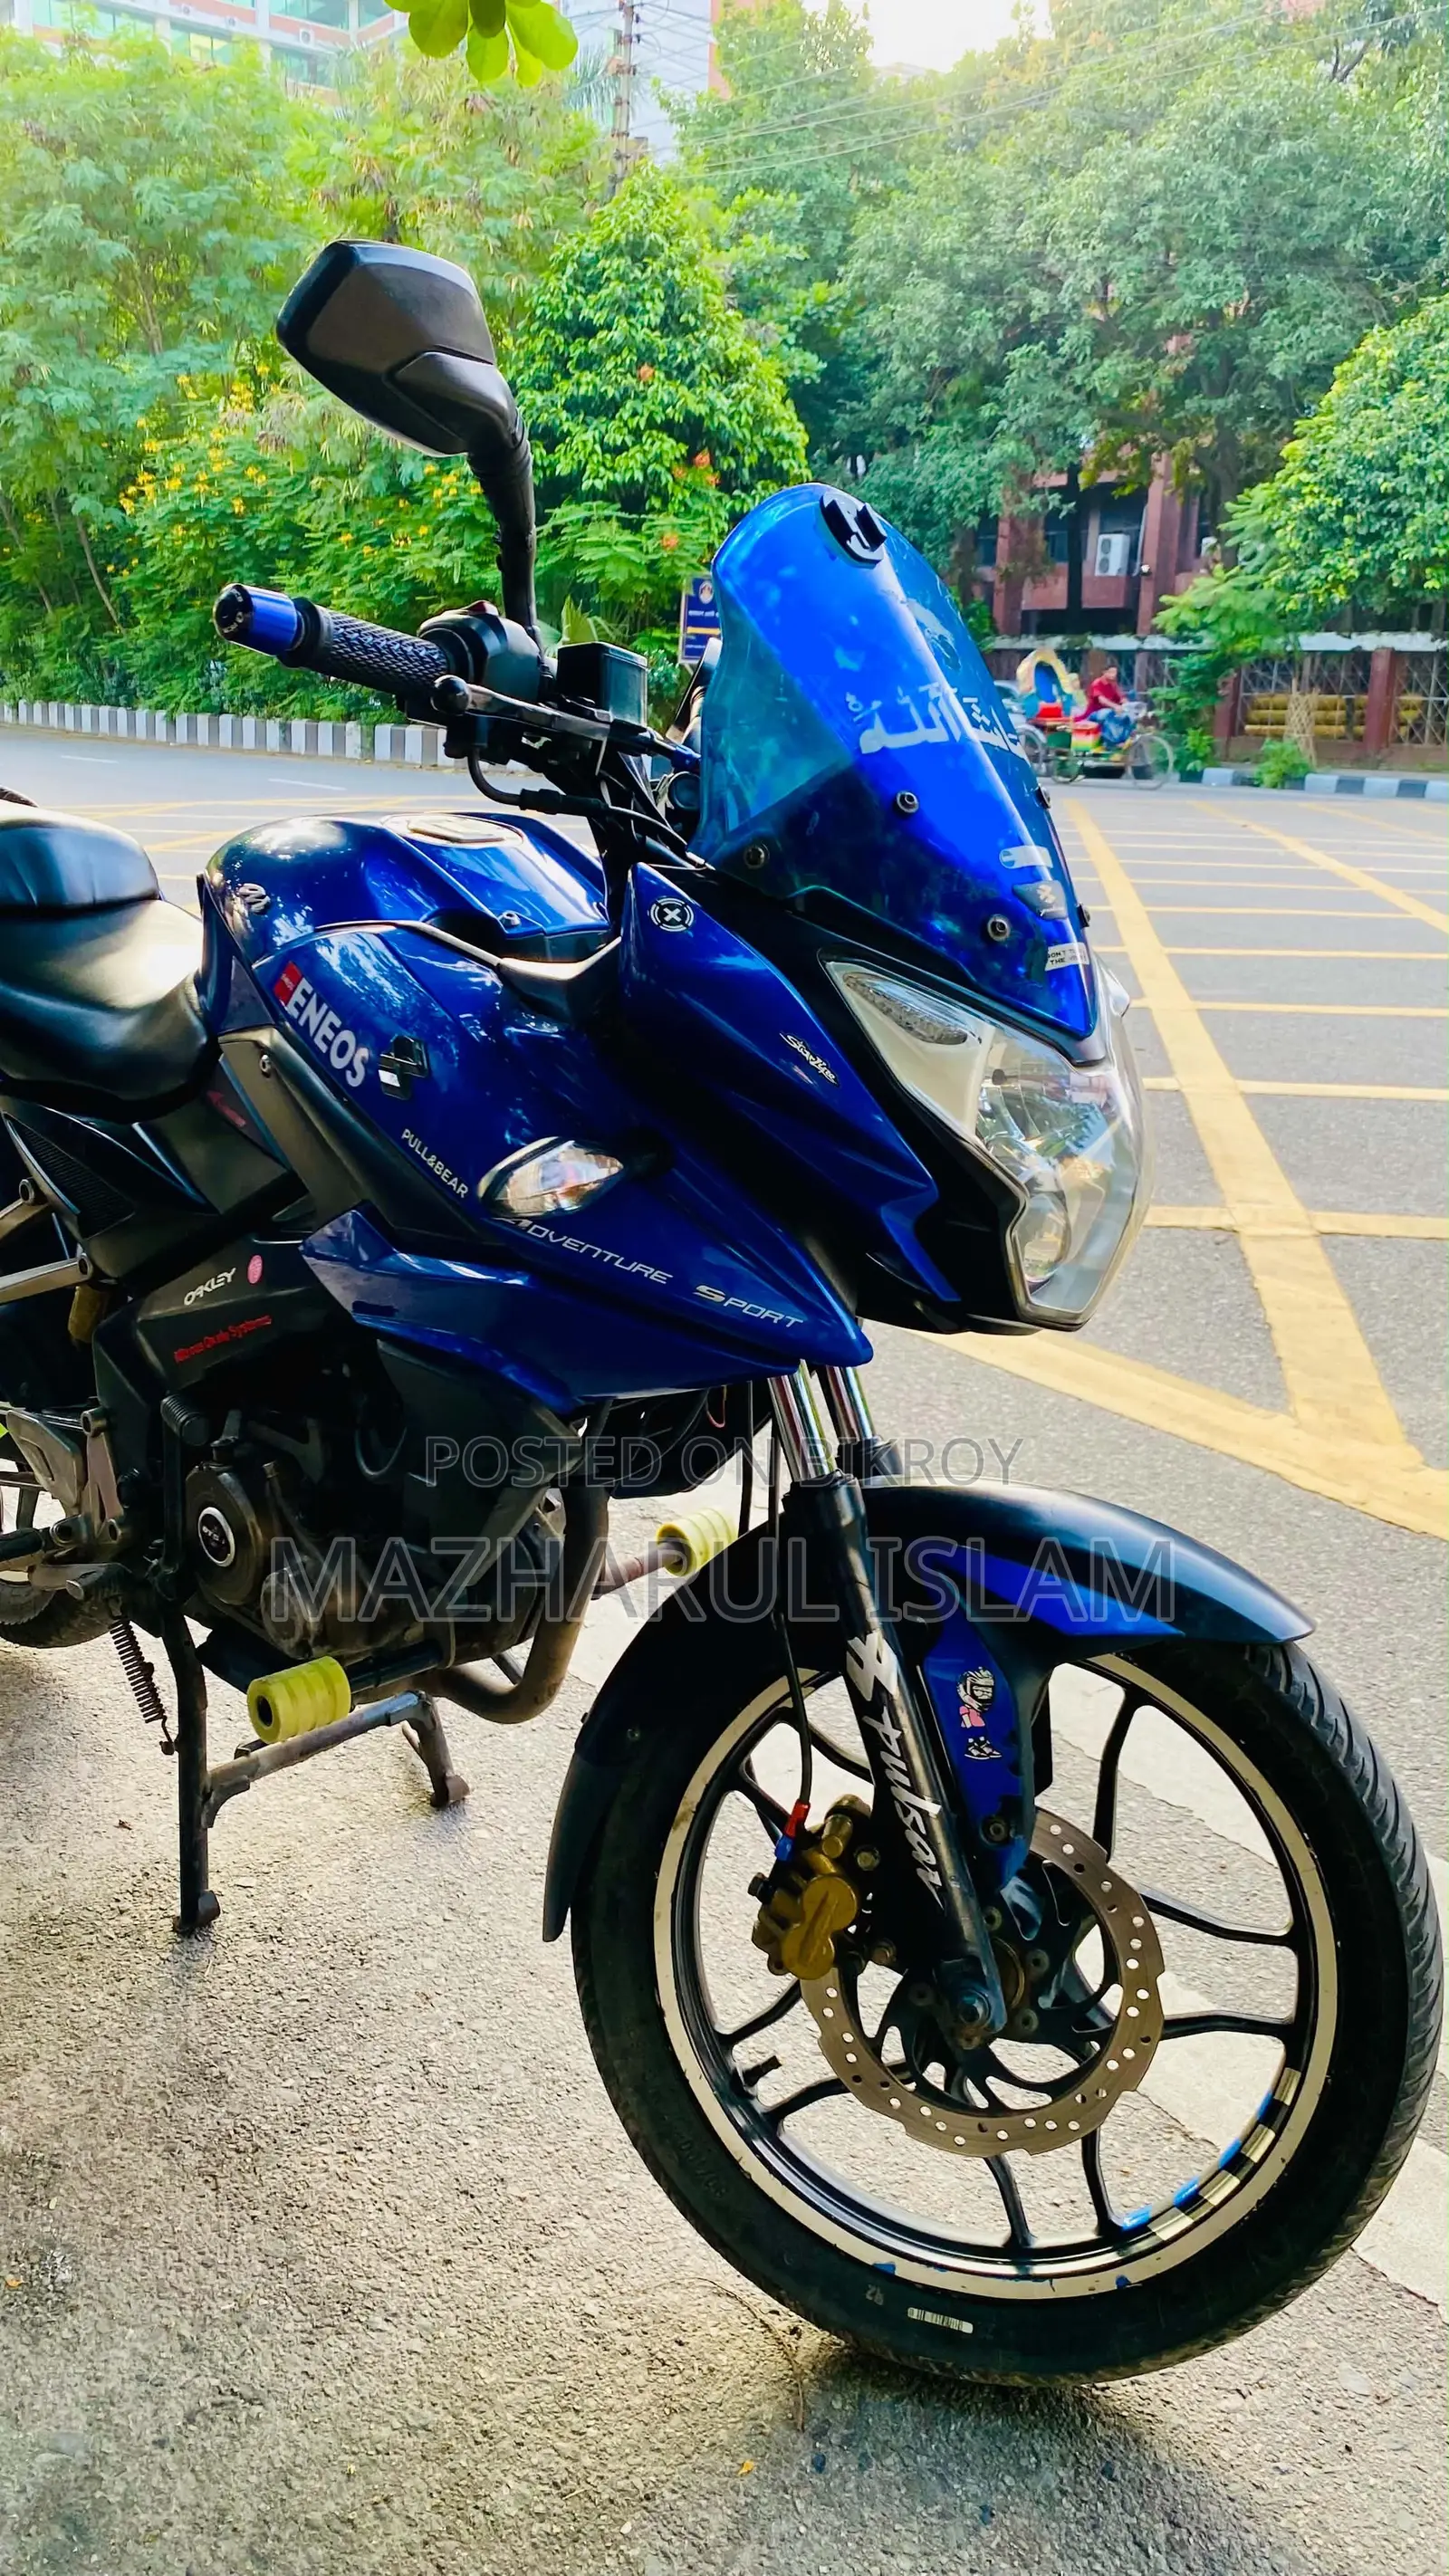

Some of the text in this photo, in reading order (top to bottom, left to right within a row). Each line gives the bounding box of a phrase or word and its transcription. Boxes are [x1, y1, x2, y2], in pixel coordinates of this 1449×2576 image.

[284, 977, 369, 1087] ENEOS
[401, 1128, 469, 1200] PULL&BEAR
[184, 1268, 236, 1305] OAKLEY
[494, 1217, 803, 1328] ADVENTURE SPORT
